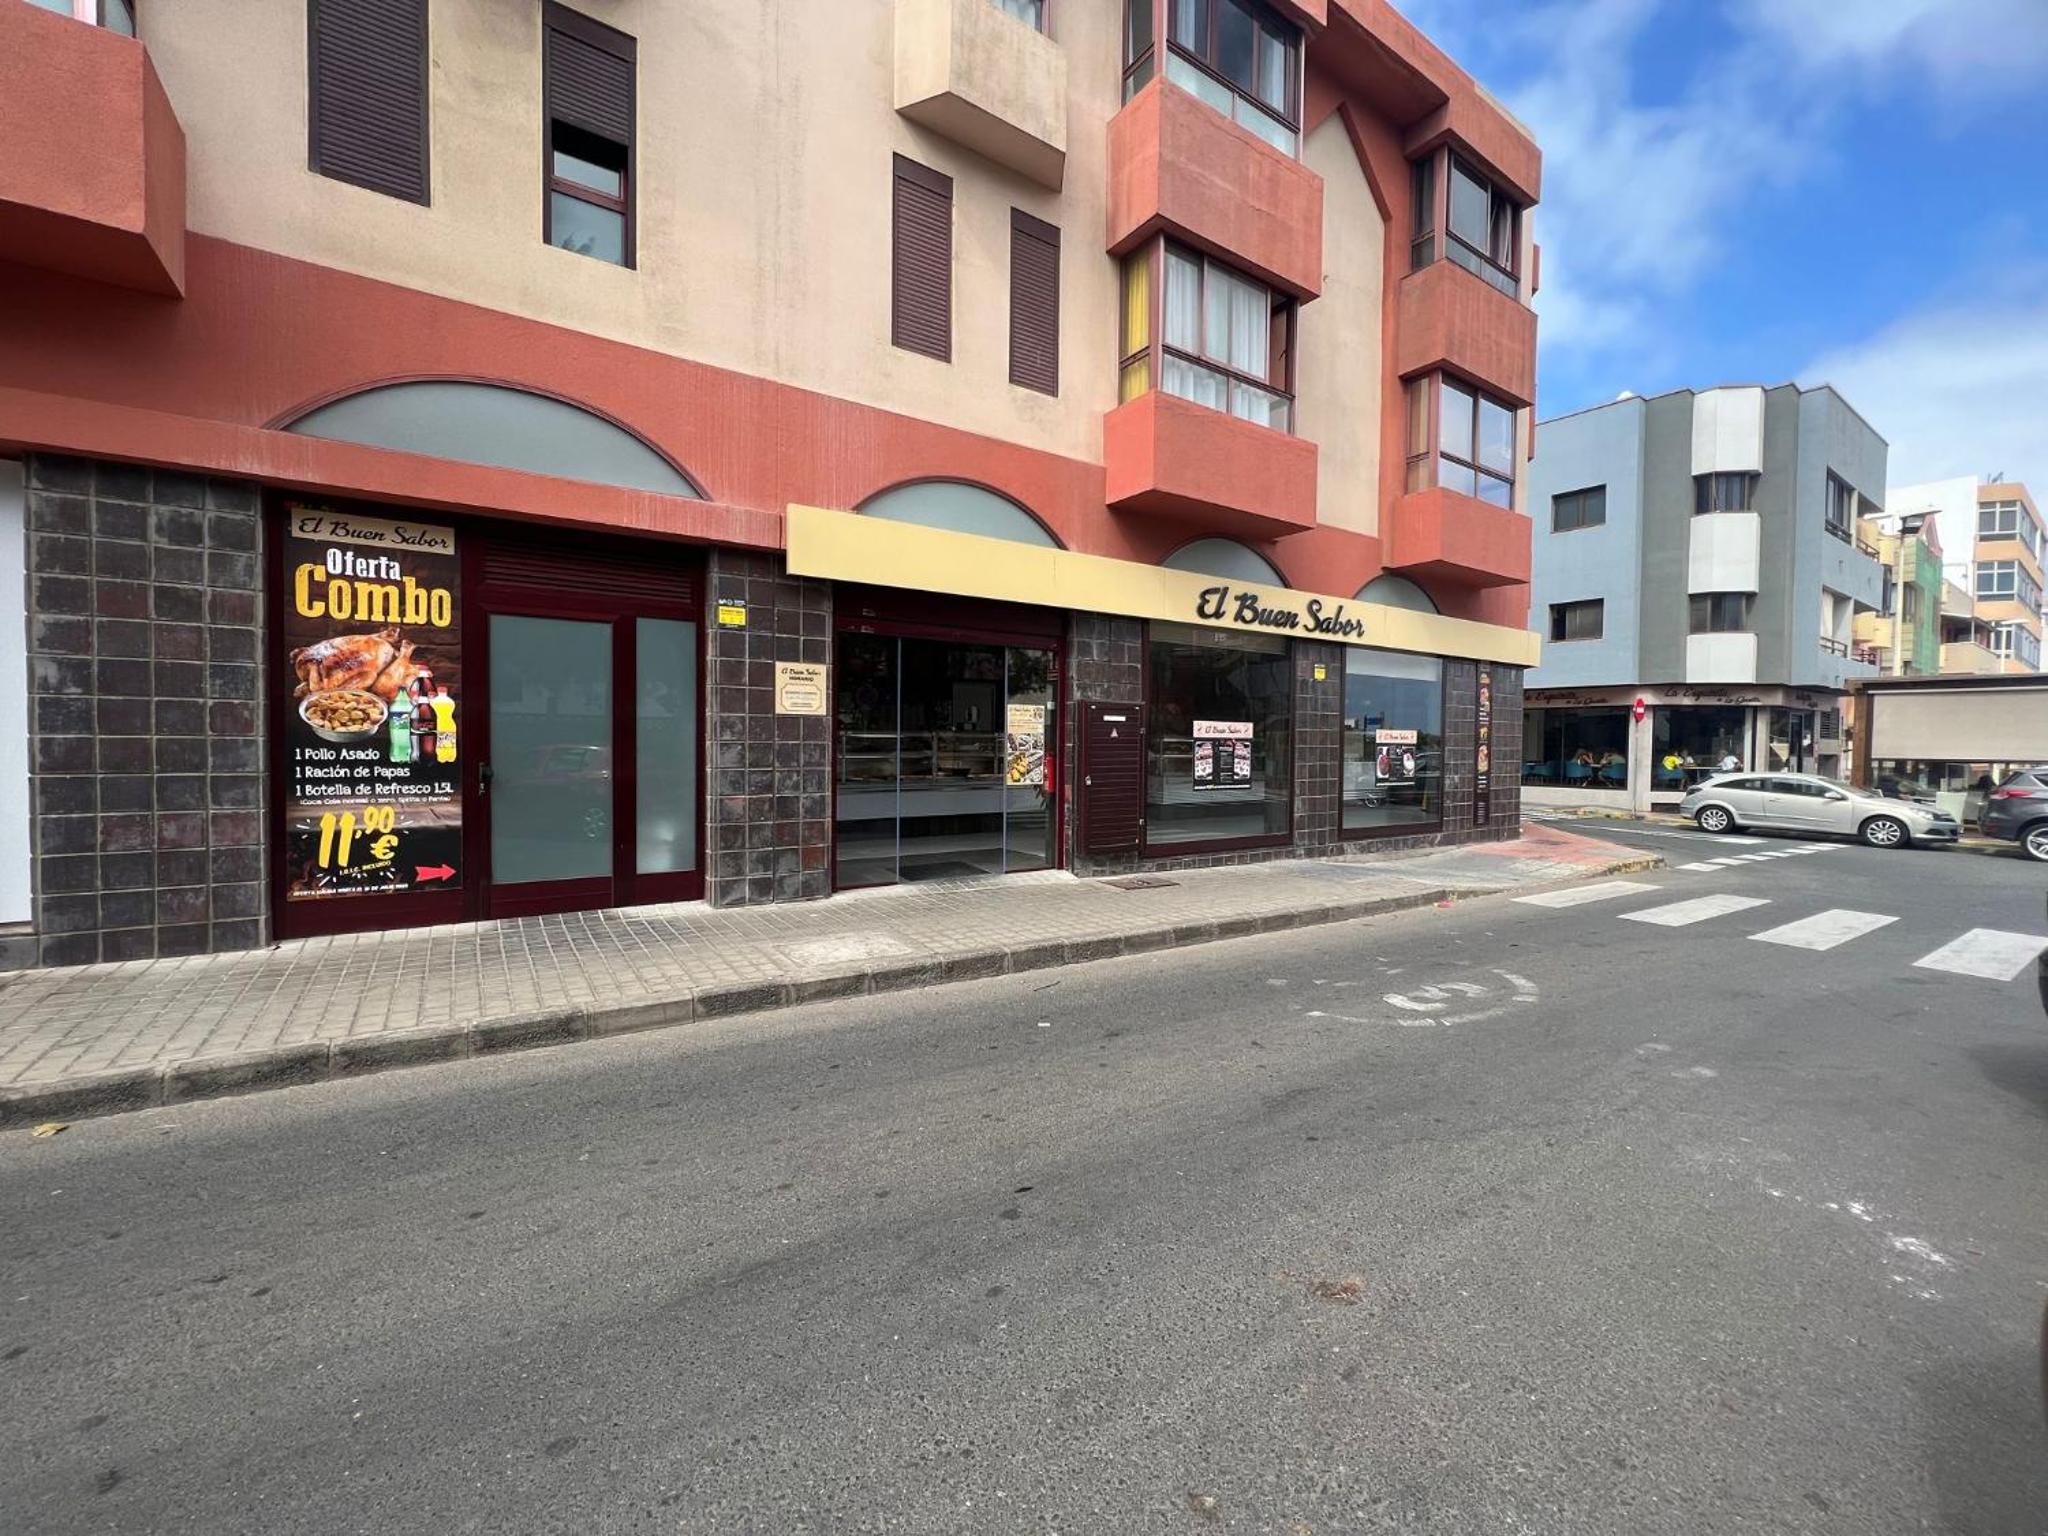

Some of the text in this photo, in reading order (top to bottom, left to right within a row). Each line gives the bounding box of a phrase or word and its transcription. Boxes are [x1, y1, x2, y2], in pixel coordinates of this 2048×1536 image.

[299, 517, 449, 549] El Buen Sabor
[326, 548, 402, 581] Oferta
[295, 563, 452, 628] Combo
[1196, 586, 1366, 638] El Buen Sabor
[295, 748, 380, 759] 1 Pollo Asado
[295, 764, 411, 780] 1 Ración de Papas
[295, 785, 301, 796] 1
[305, 784, 352, 796] Botella
[354, 784, 372, 795] de
[375, 782, 431, 795] Refresco
[370, 834, 399, 860] €
